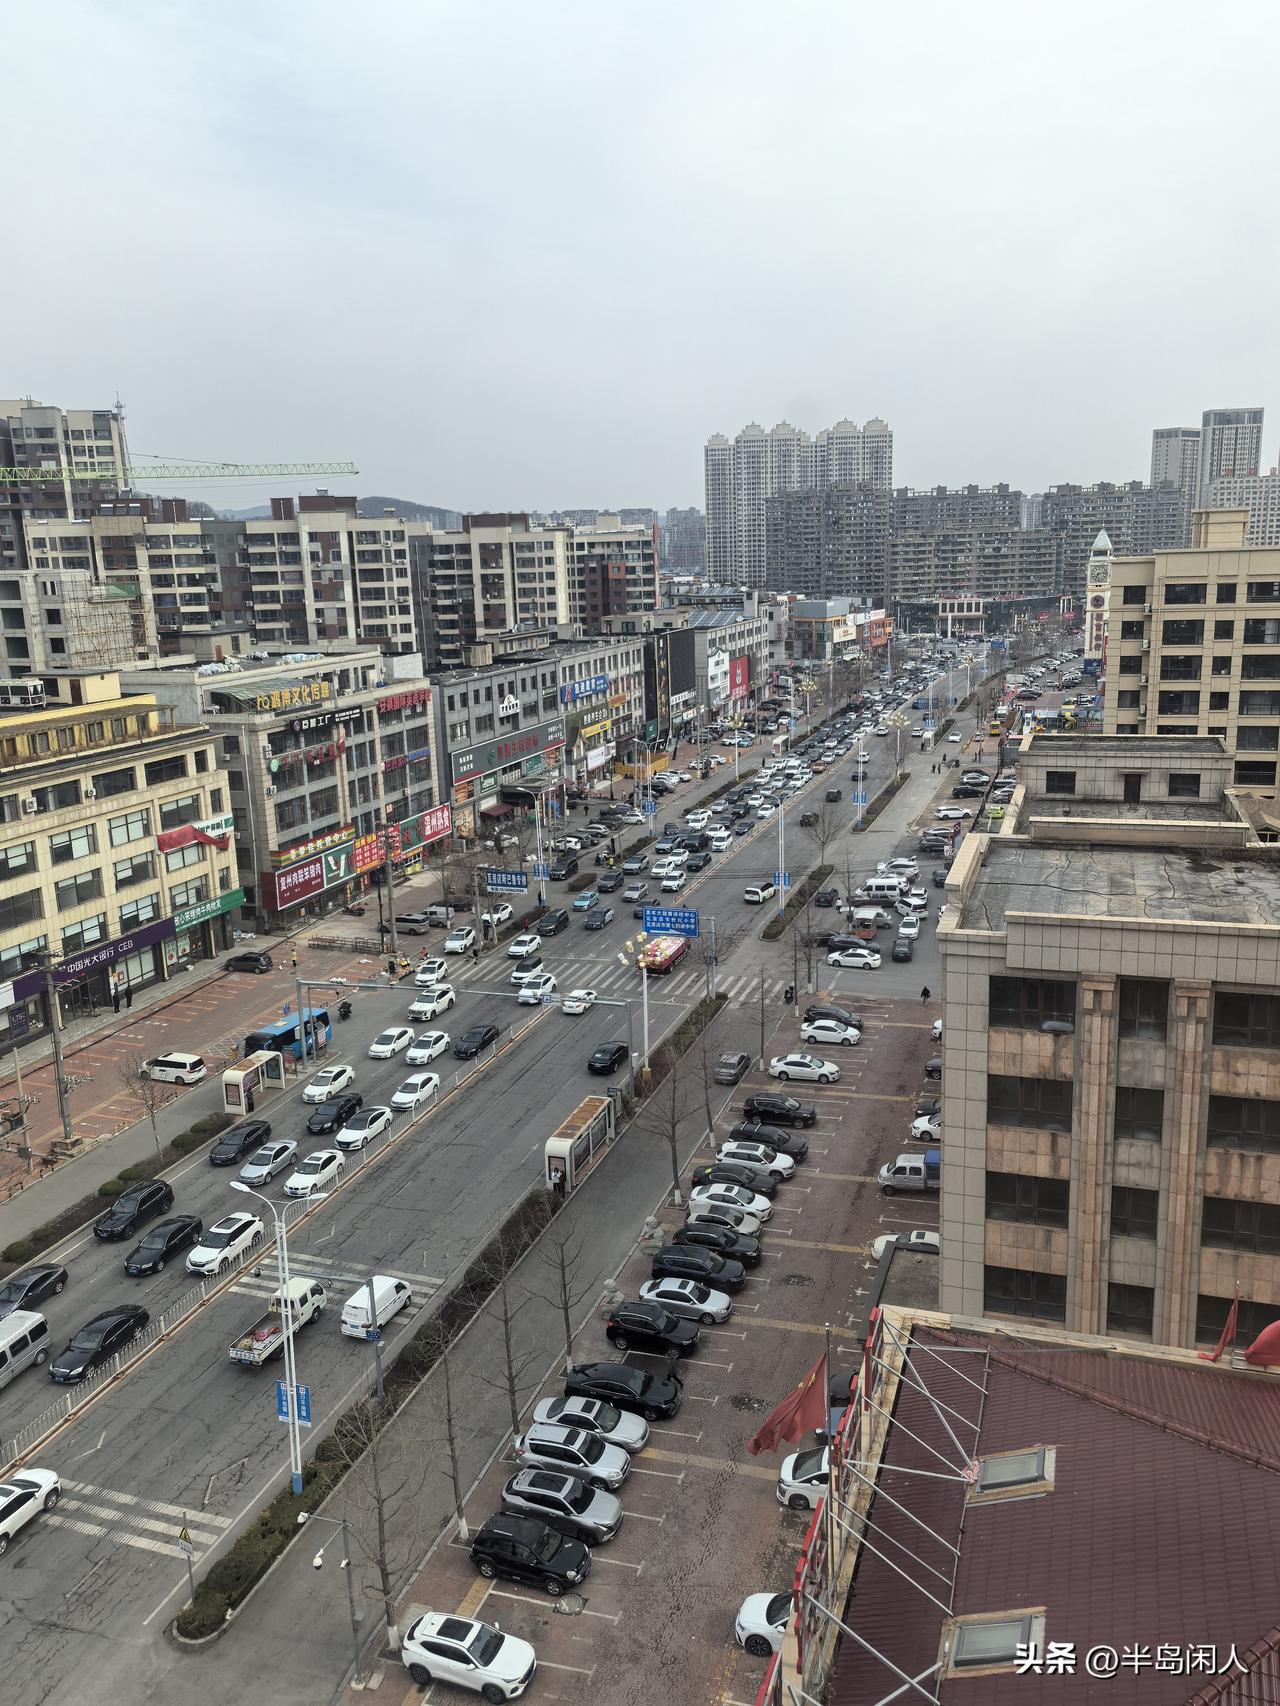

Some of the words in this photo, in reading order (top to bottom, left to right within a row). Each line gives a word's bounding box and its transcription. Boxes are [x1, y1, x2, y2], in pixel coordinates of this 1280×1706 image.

[271, 681, 329, 709] 鸿博文化传媒
[424, 807, 449, 835] 温州熟食
[487, 873, 526, 886] 瓦房店斯巴鲁专修
[118, 940, 134, 951] CEB
[67, 948, 114, 974] 中国光大银行
